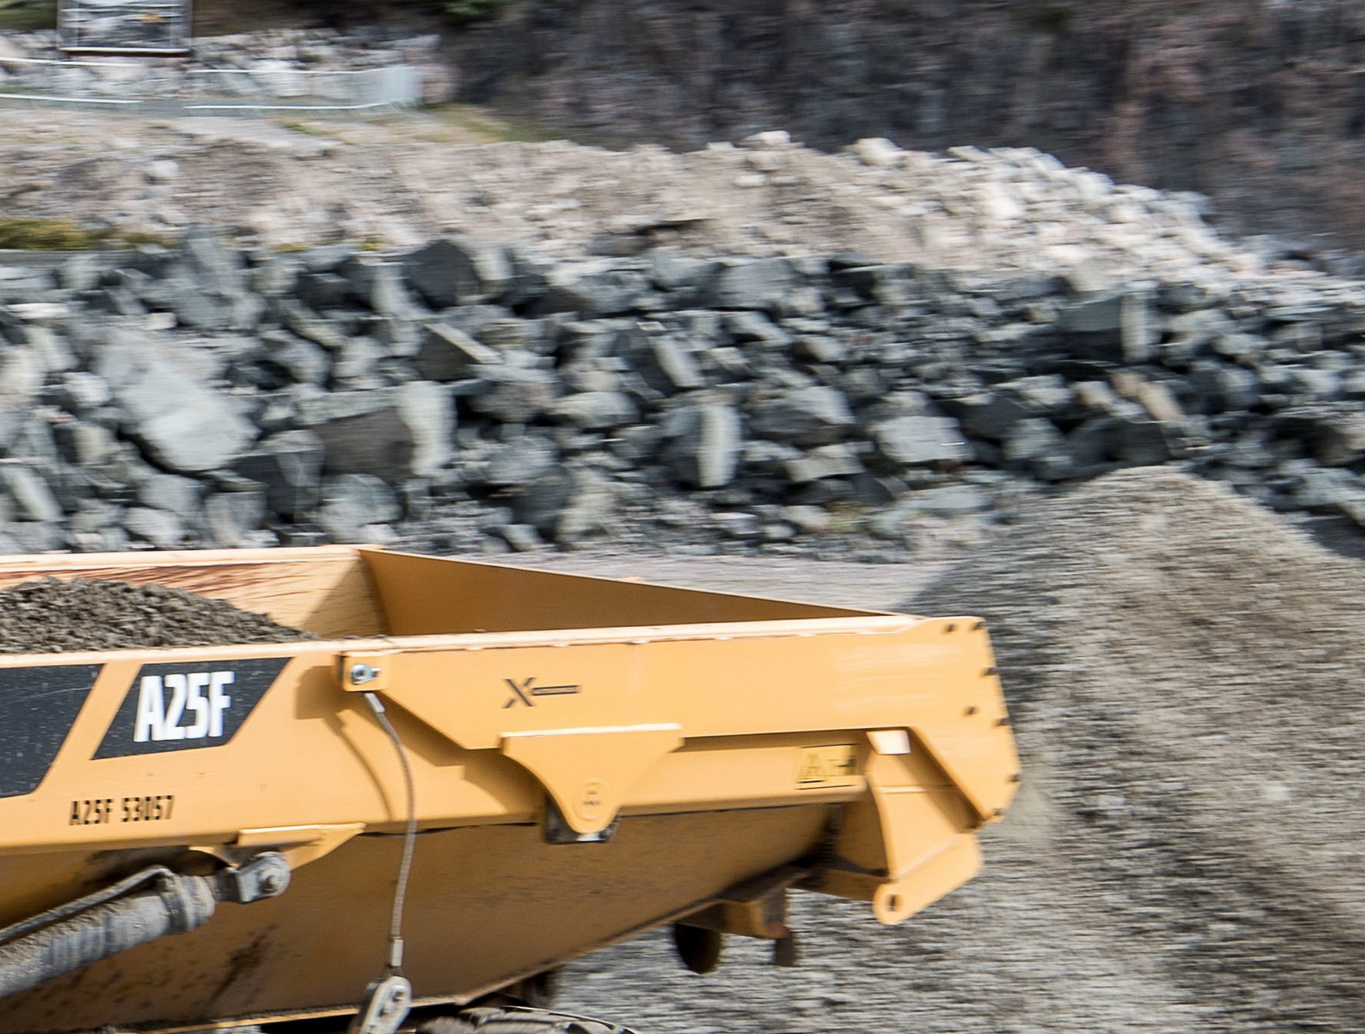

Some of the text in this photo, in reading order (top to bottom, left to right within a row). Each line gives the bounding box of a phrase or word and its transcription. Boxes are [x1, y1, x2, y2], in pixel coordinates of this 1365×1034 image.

[133, 671, 235, 743] A25F
[69, 795, 174, 826] A25F 53057
